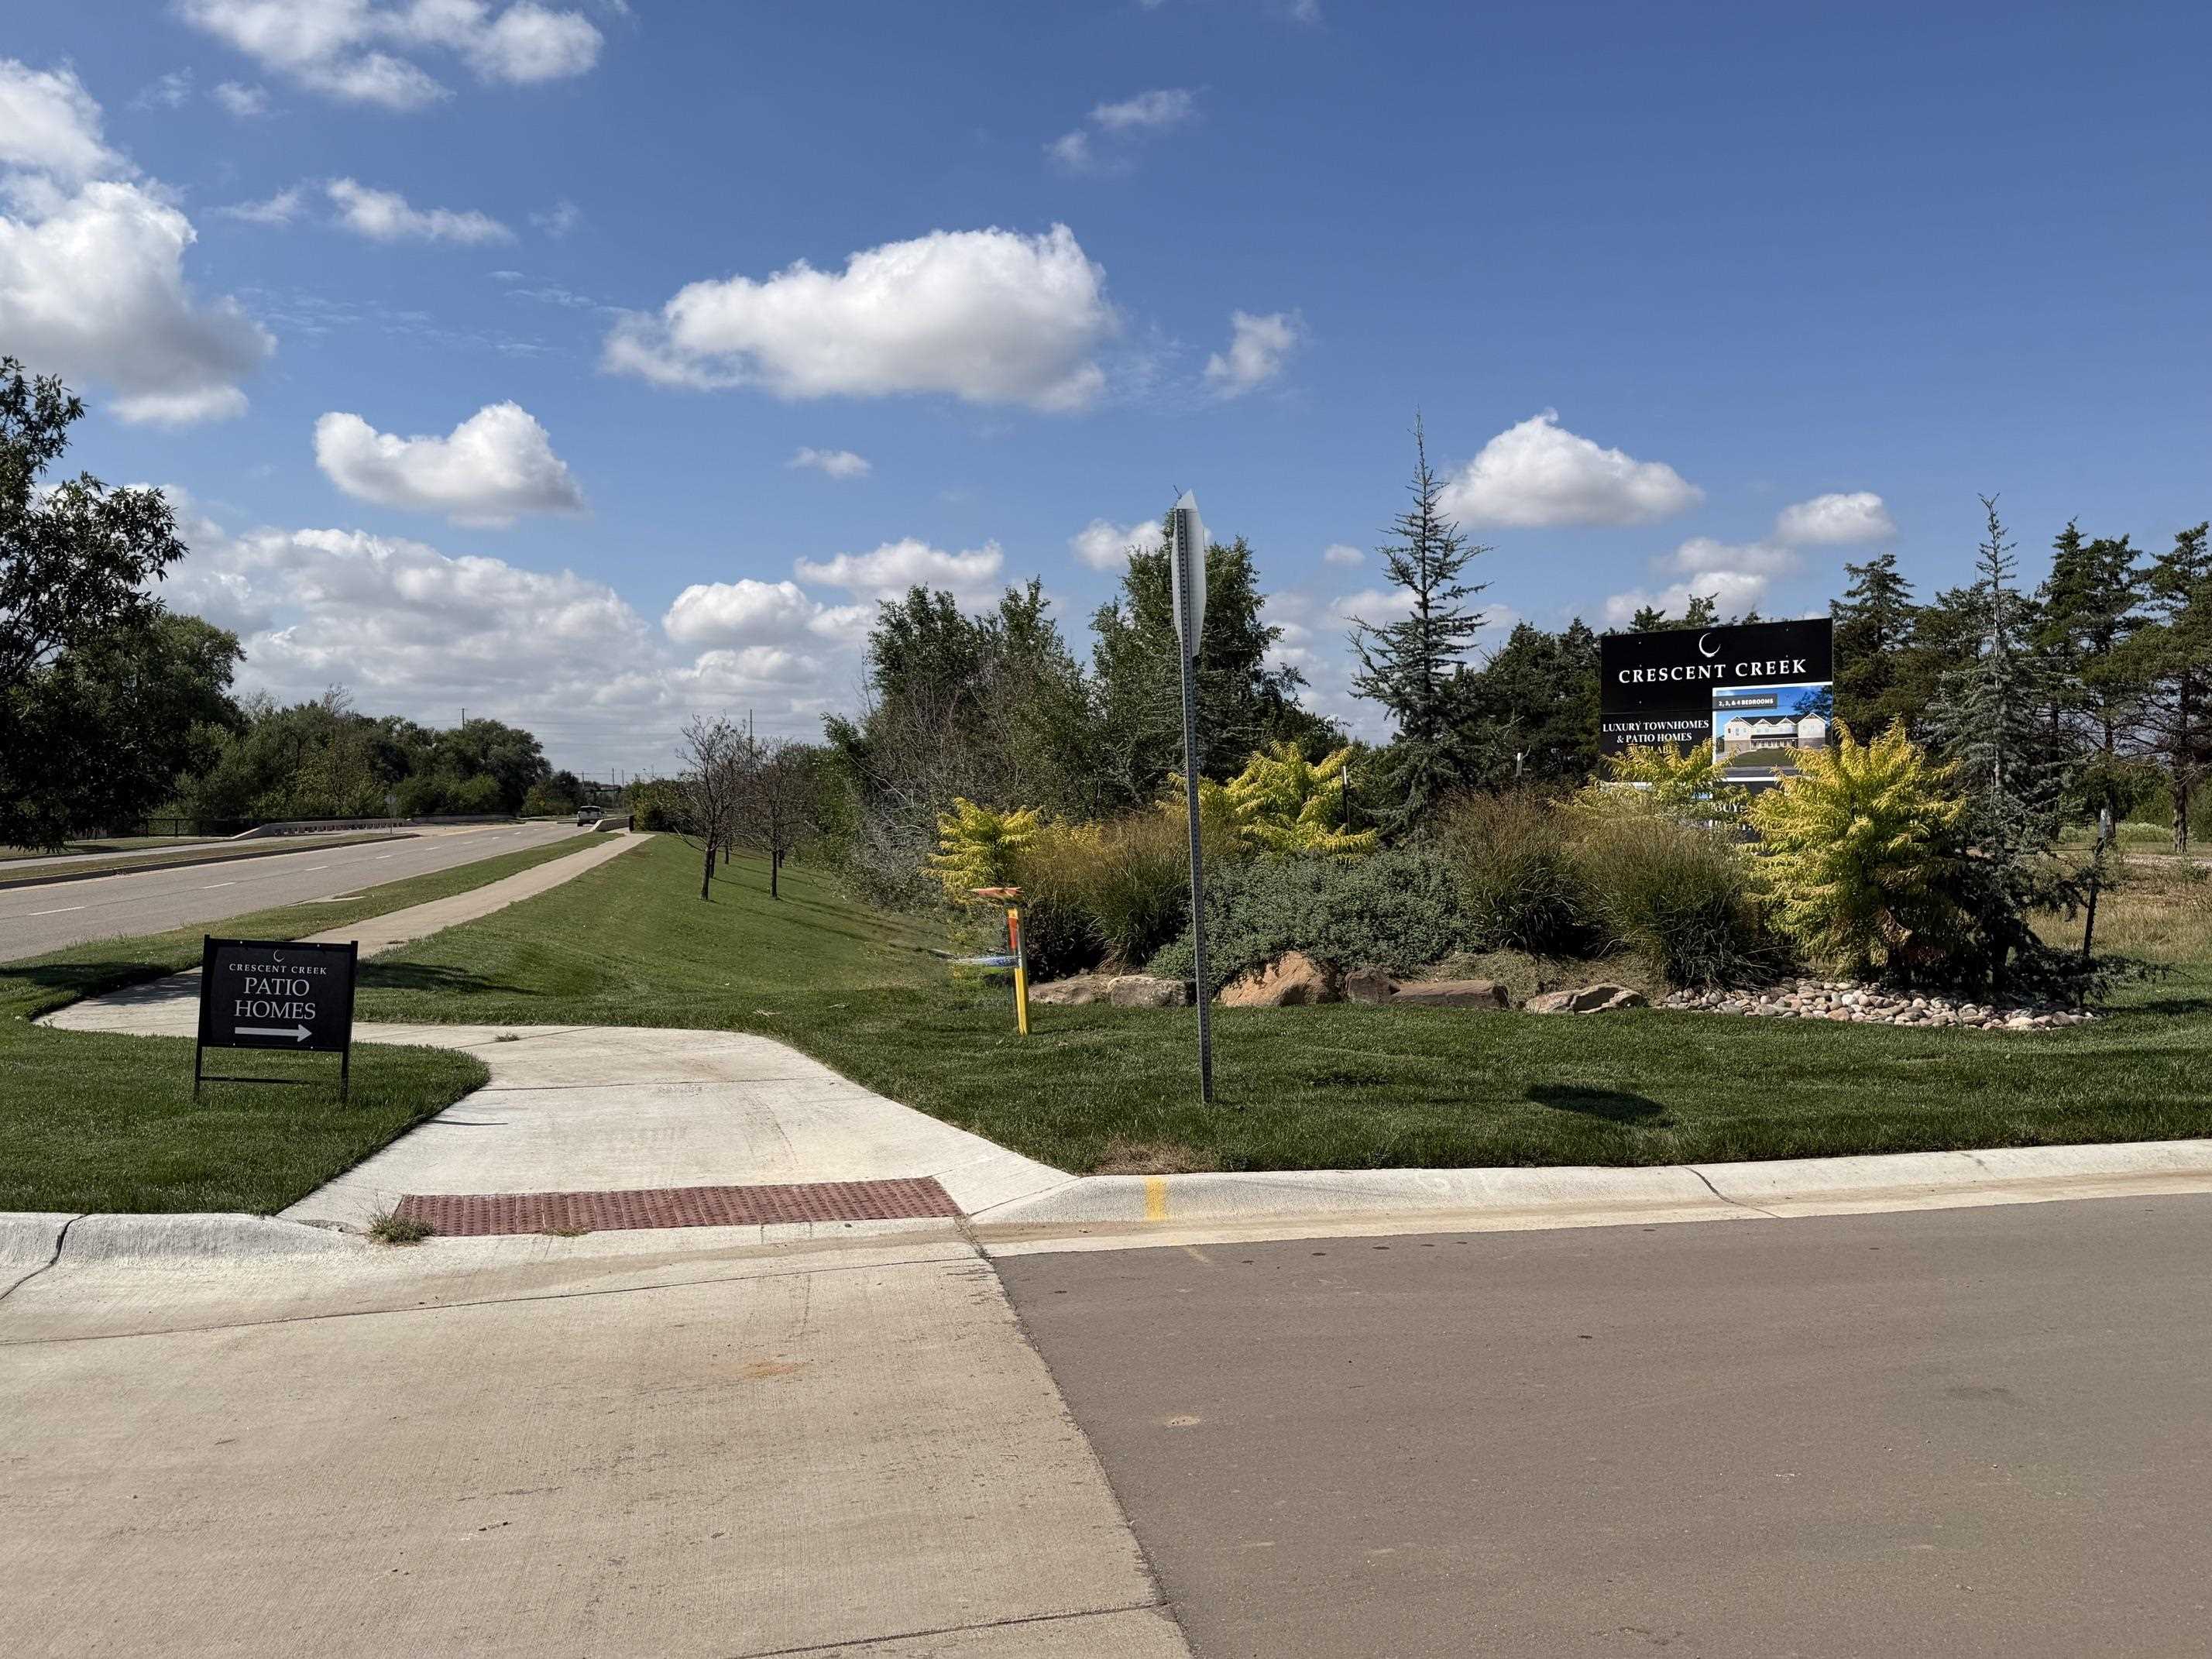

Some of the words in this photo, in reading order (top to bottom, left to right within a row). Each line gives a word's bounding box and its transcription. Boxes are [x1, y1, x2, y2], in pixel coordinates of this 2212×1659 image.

[1619, 664, 1726, 683] CRESCENT
[1735, 659, 1806, 677] CREEK
[1602, 723, 1641, 733] LUXURY
[1643, 720, 1709, 730] TOWNHOMES
[1616, 734, 1624, 744] &
[1626, 733, 1655, 743] PATIO
[1657, 733, 1692, 742] HOMES
[229, 963, 287, 973] CRESCENT
[291, 966, 327, 974] CREEK
[243, 977, 310, 996] PATIO
[233, 999, 317, 1020] HOMES
